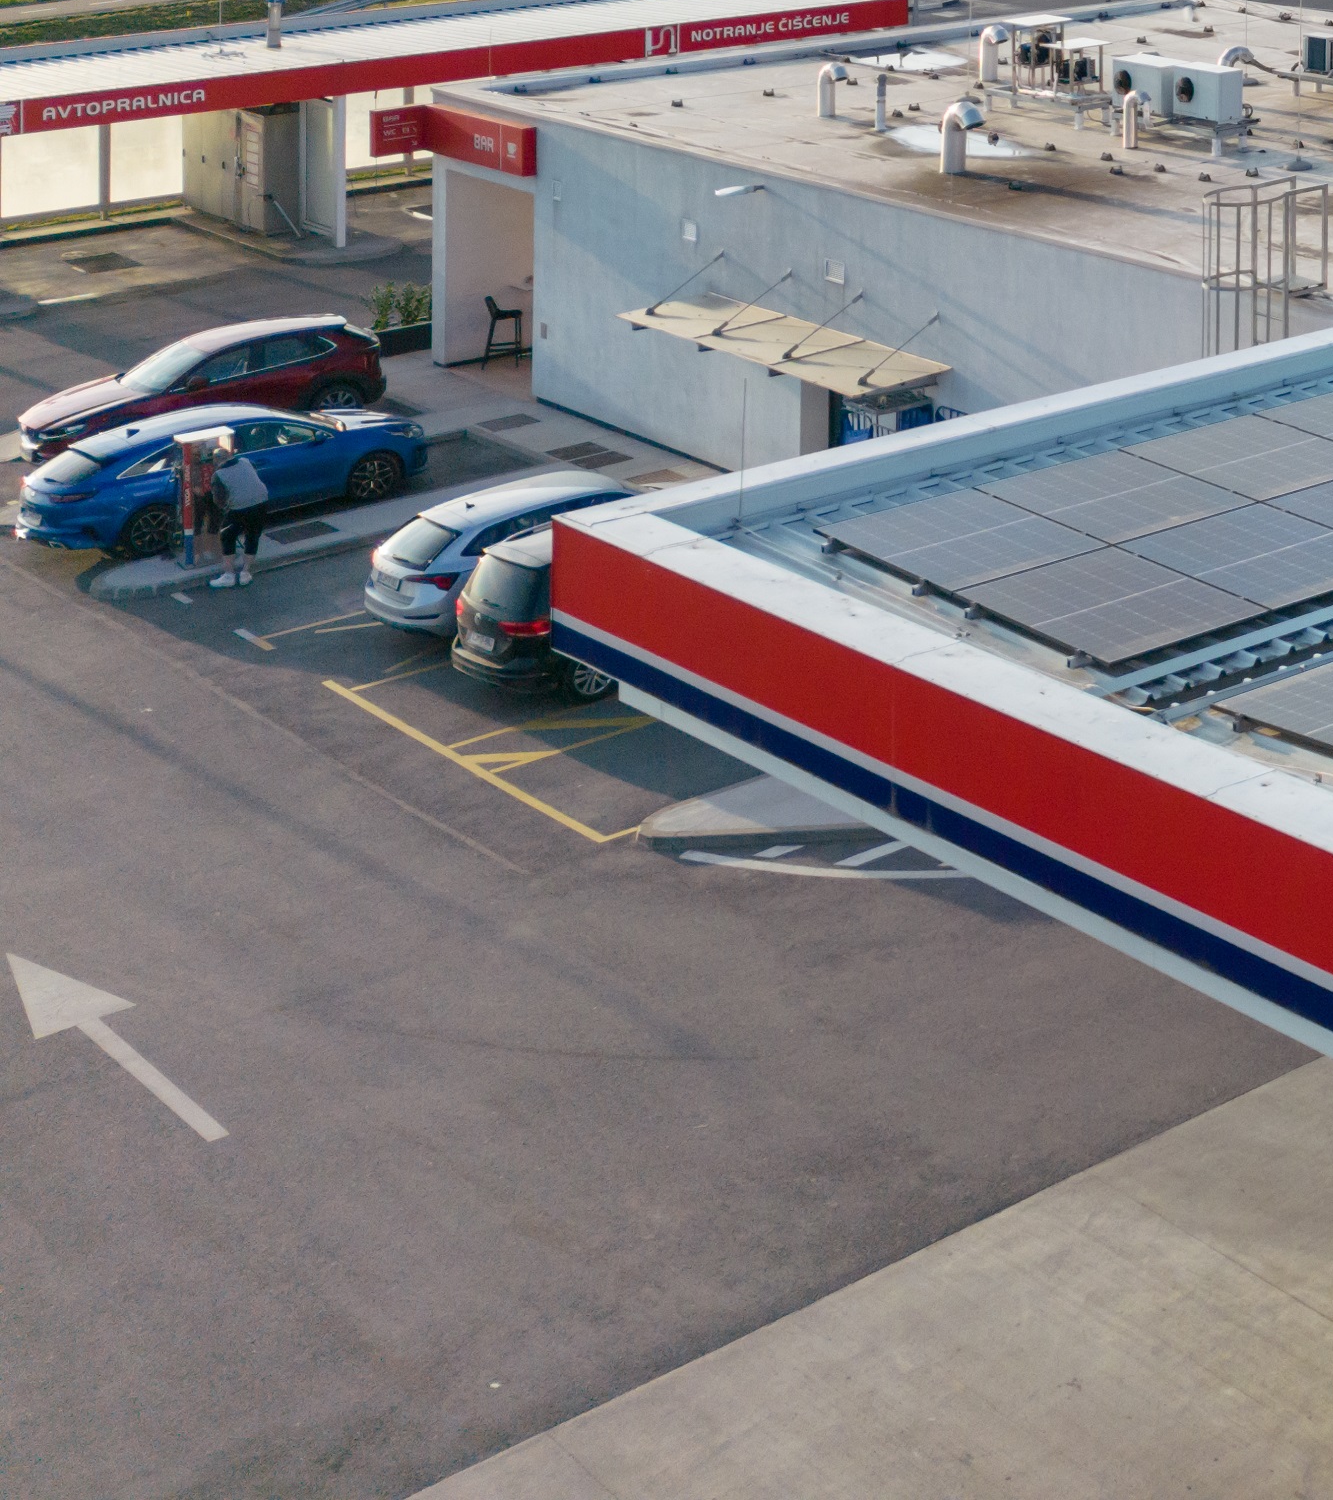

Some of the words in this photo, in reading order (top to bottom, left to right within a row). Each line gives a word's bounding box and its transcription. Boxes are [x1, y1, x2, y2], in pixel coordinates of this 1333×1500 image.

[691, 21, 775, 43] NOTRANJE
[778, 12, 850, 32] ČIŠČENJE
[42, 88, 206, 121] AVTOPRALNICA
[473, 133, 494, 153] BAR
